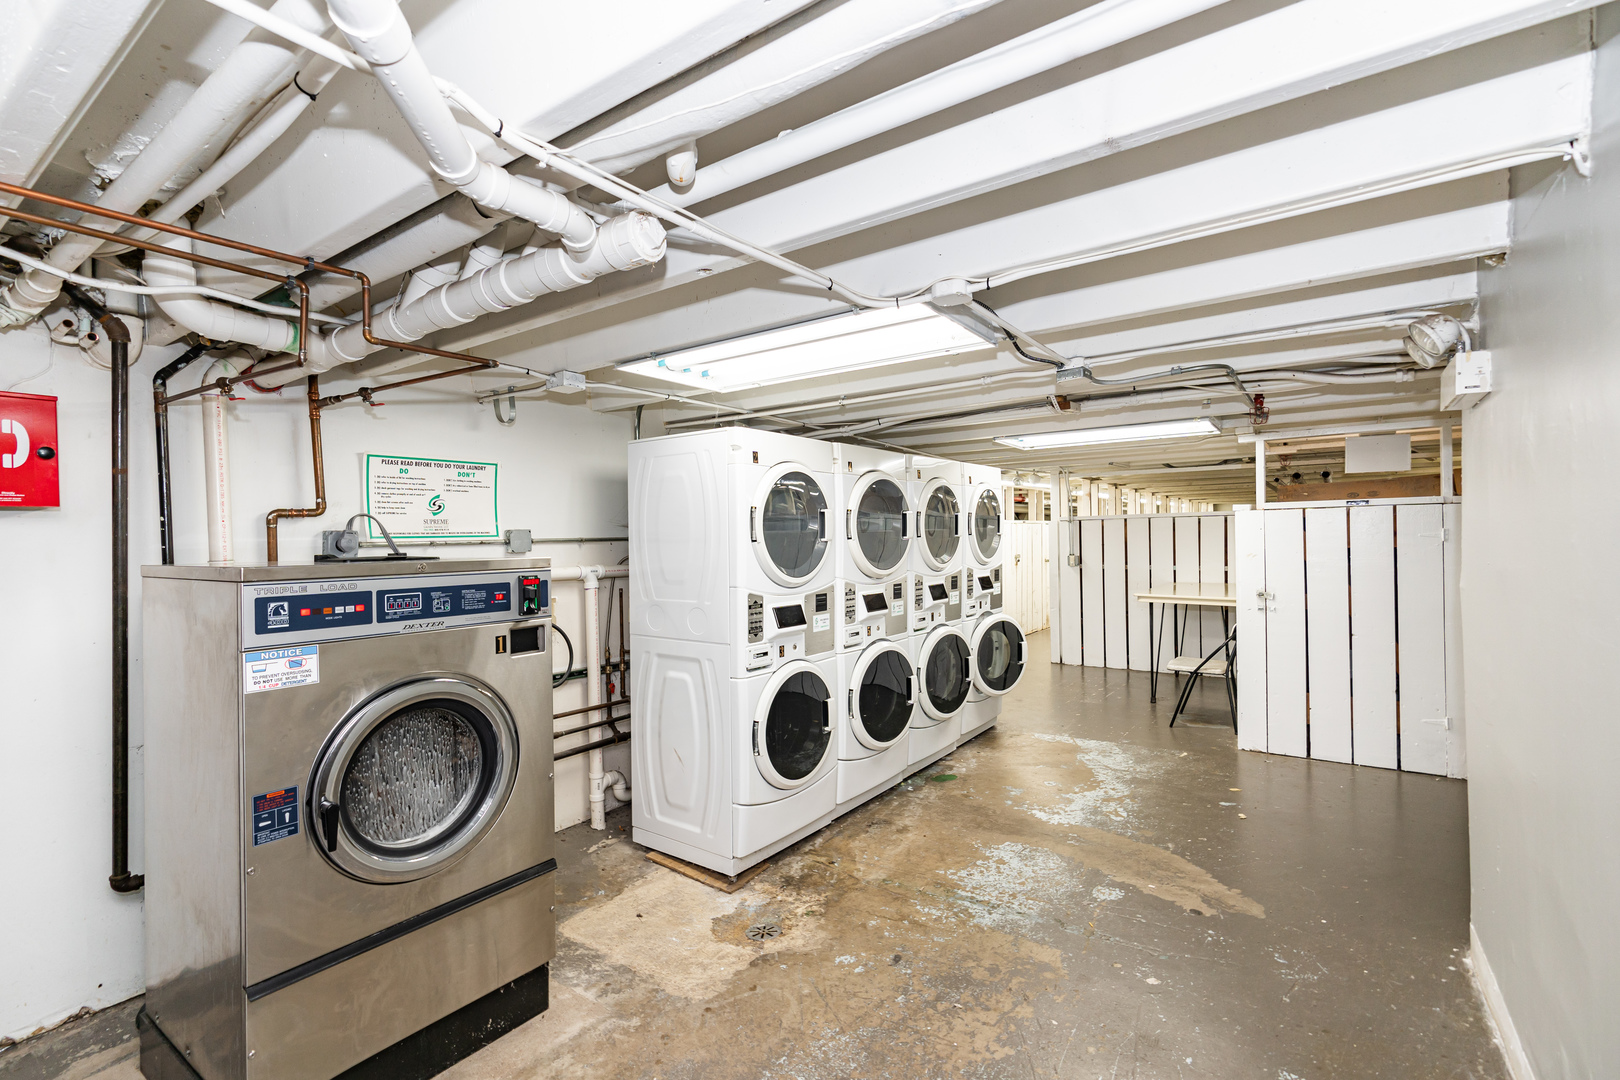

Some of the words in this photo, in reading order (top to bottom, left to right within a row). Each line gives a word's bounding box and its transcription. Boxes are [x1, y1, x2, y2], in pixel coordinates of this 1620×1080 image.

[254, 585, 308, 595] TRIPLE
[320, 583, 357, 592] LOAD
[403, 621, 445, 630] DEXTER
[496, 636, 505, 653] 1
[261, 649, 302, 659] NOTICE
